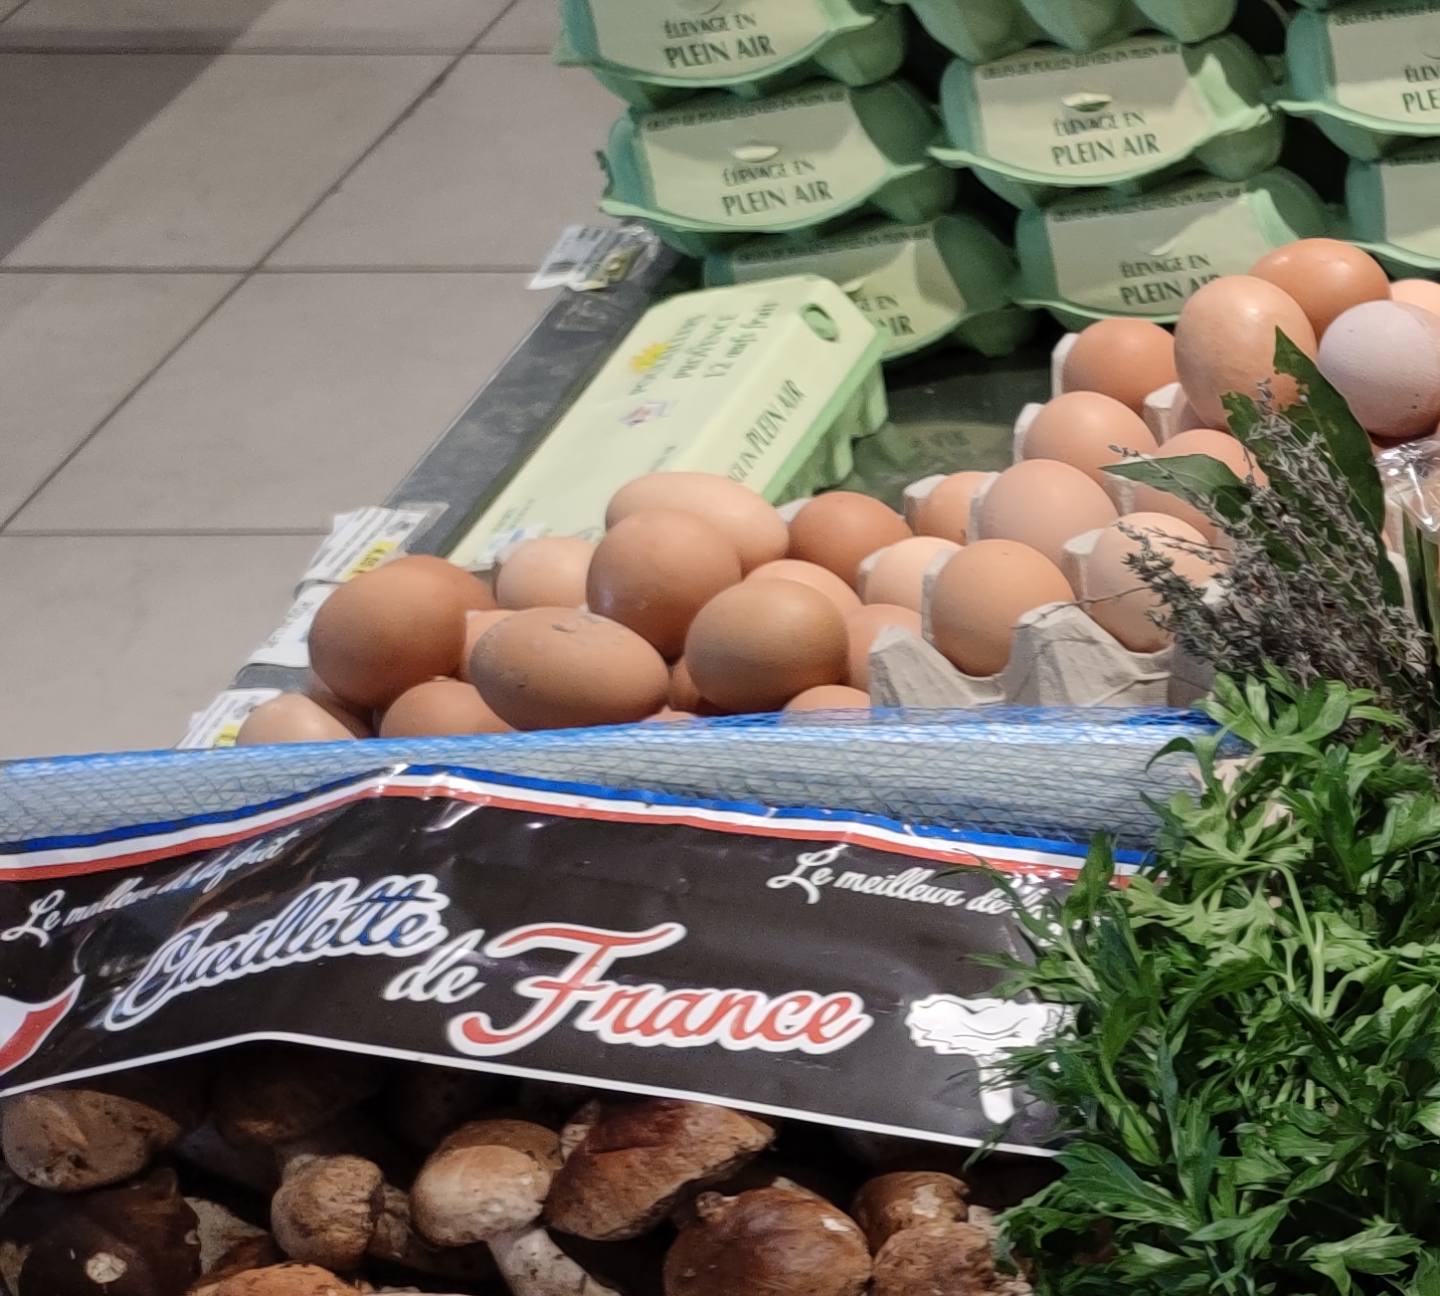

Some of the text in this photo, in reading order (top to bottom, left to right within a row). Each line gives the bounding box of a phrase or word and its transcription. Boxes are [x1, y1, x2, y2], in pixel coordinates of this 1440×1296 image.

[664, 35, 776, 69] PLEIN AIR
[1052, 133, 1161, 167] PLEIN AIR
[721, 181, 832, 217] PLEIN AIR
[1120, 282, 1183, 306] PLEIN
[746, 405, 786, 446] PLEIN
[766, 843, 849, 904] Le
[833, 867, 966, 908] meilleur
[0, 889, 65, 947] Le
[384, 922, 874, 1057] de France
